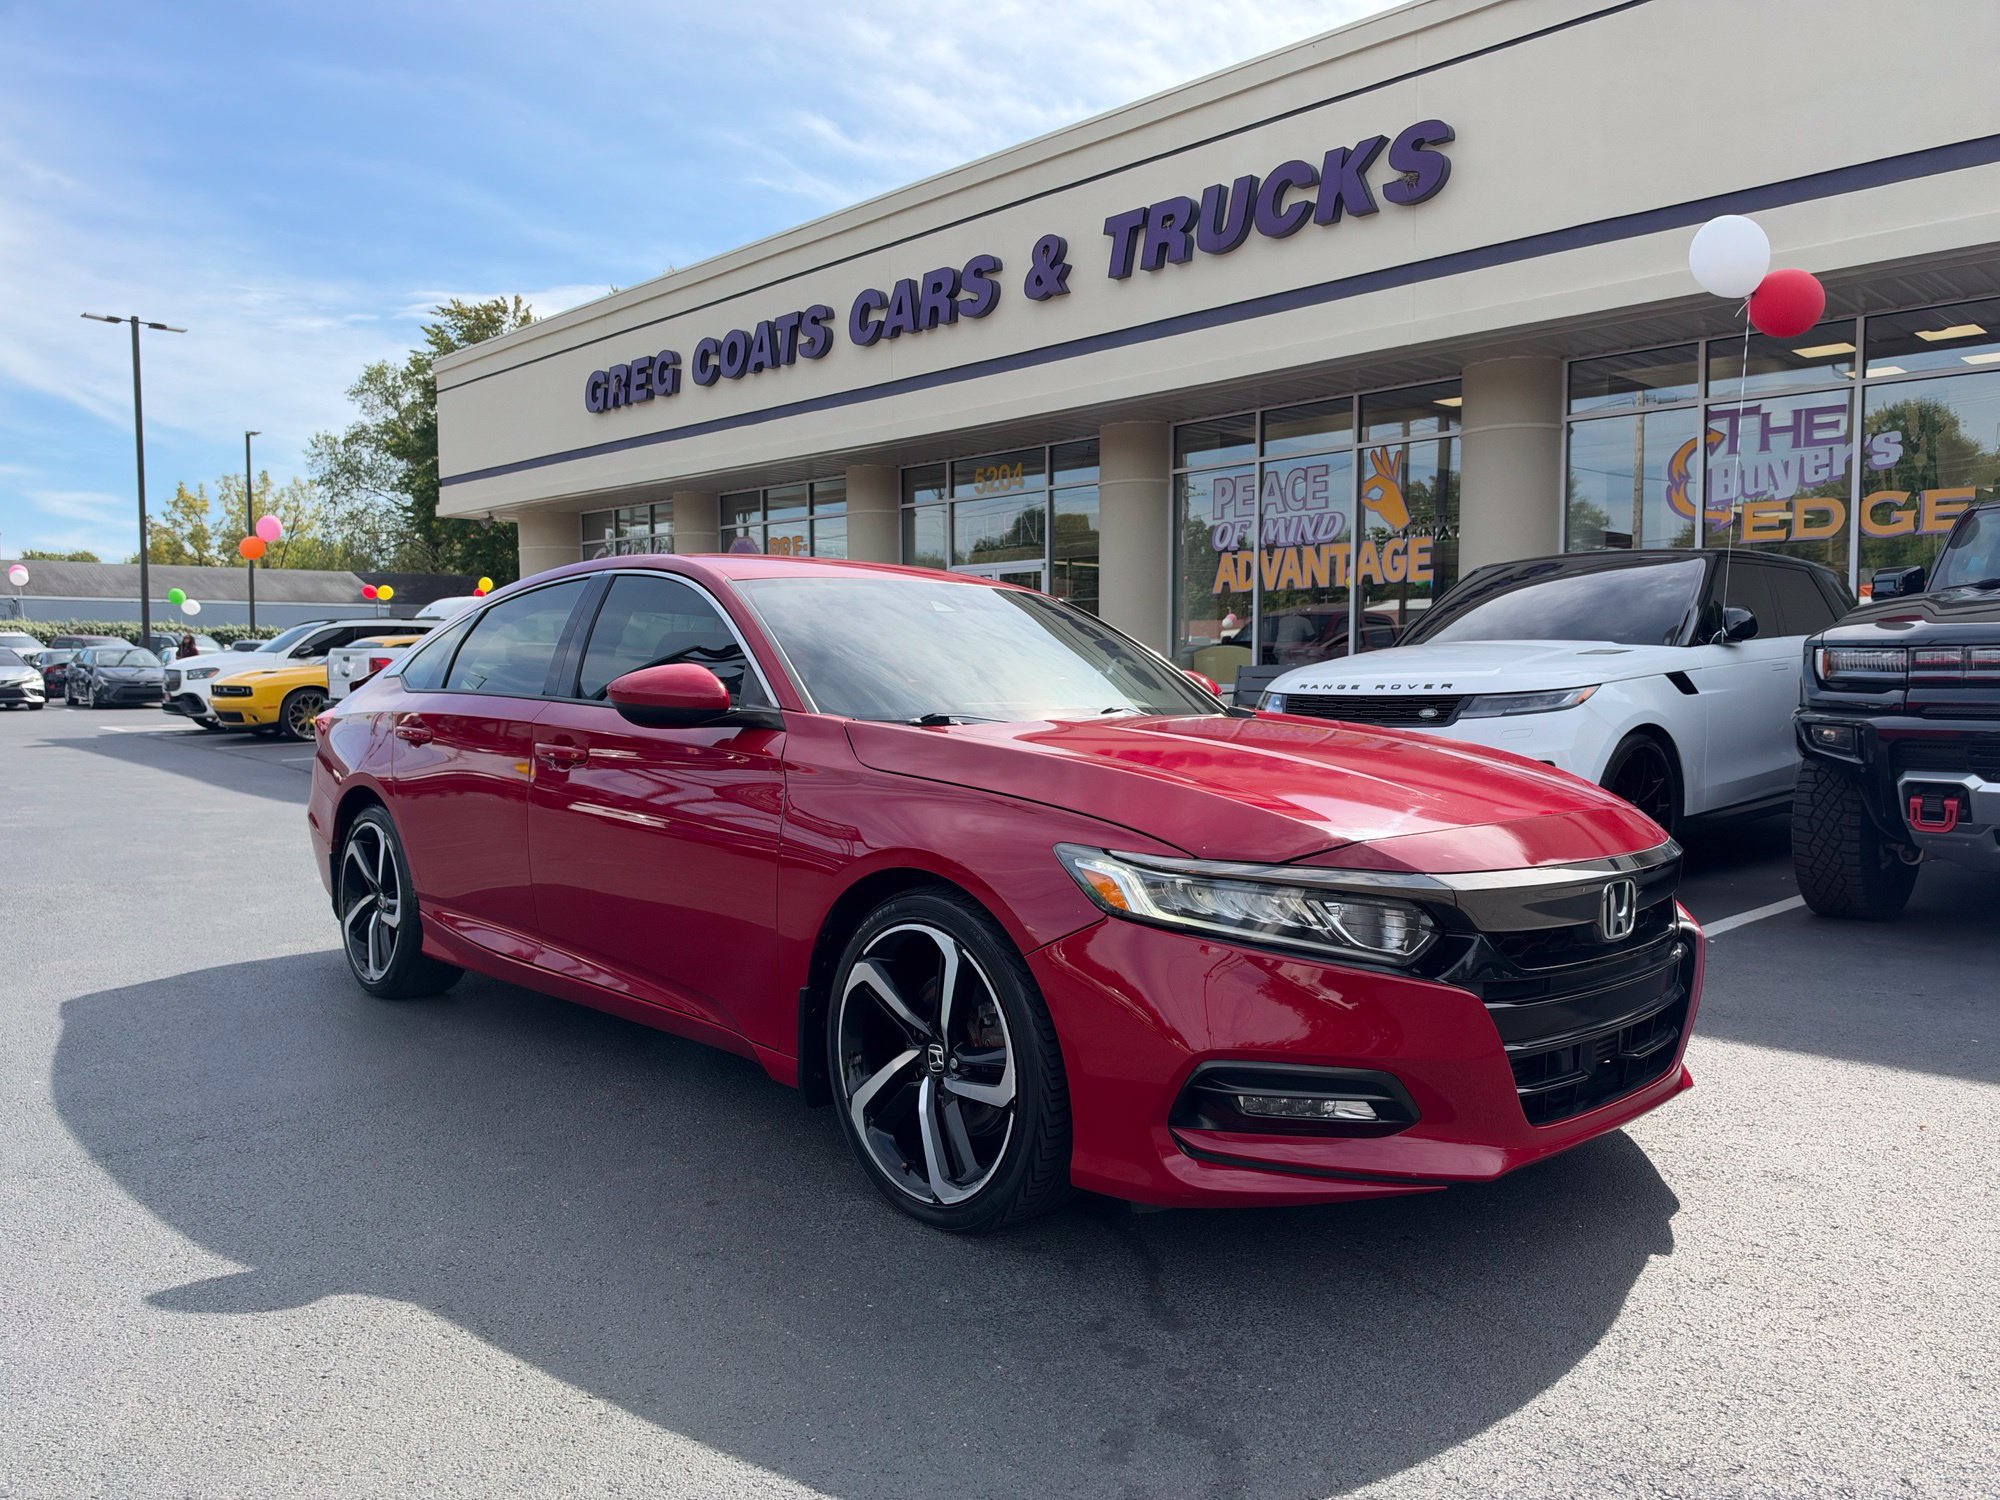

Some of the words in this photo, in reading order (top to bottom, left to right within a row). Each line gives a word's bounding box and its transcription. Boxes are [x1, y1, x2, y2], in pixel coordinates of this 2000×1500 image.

[585, 349, 681, 414] GREG
[692, 303, 835, 387] COATS
[849, 253, 1003, 347] CARS
[1024, 233, 1073, 301] &
[1103, 119, 1456, 281] TRUCKS
[1707, 404, 1847, 455] THE
[974, 462, 1025, 495] 5204
[1212, 464, 1329, 521] PEACE
[1212, 520, 1250, 551] OF
[1261, 512, 1345, 548] MIND
[1739, 486, 1976, 544] EDGE
[1212, 535, 1434, 595] ADVANTAGE
